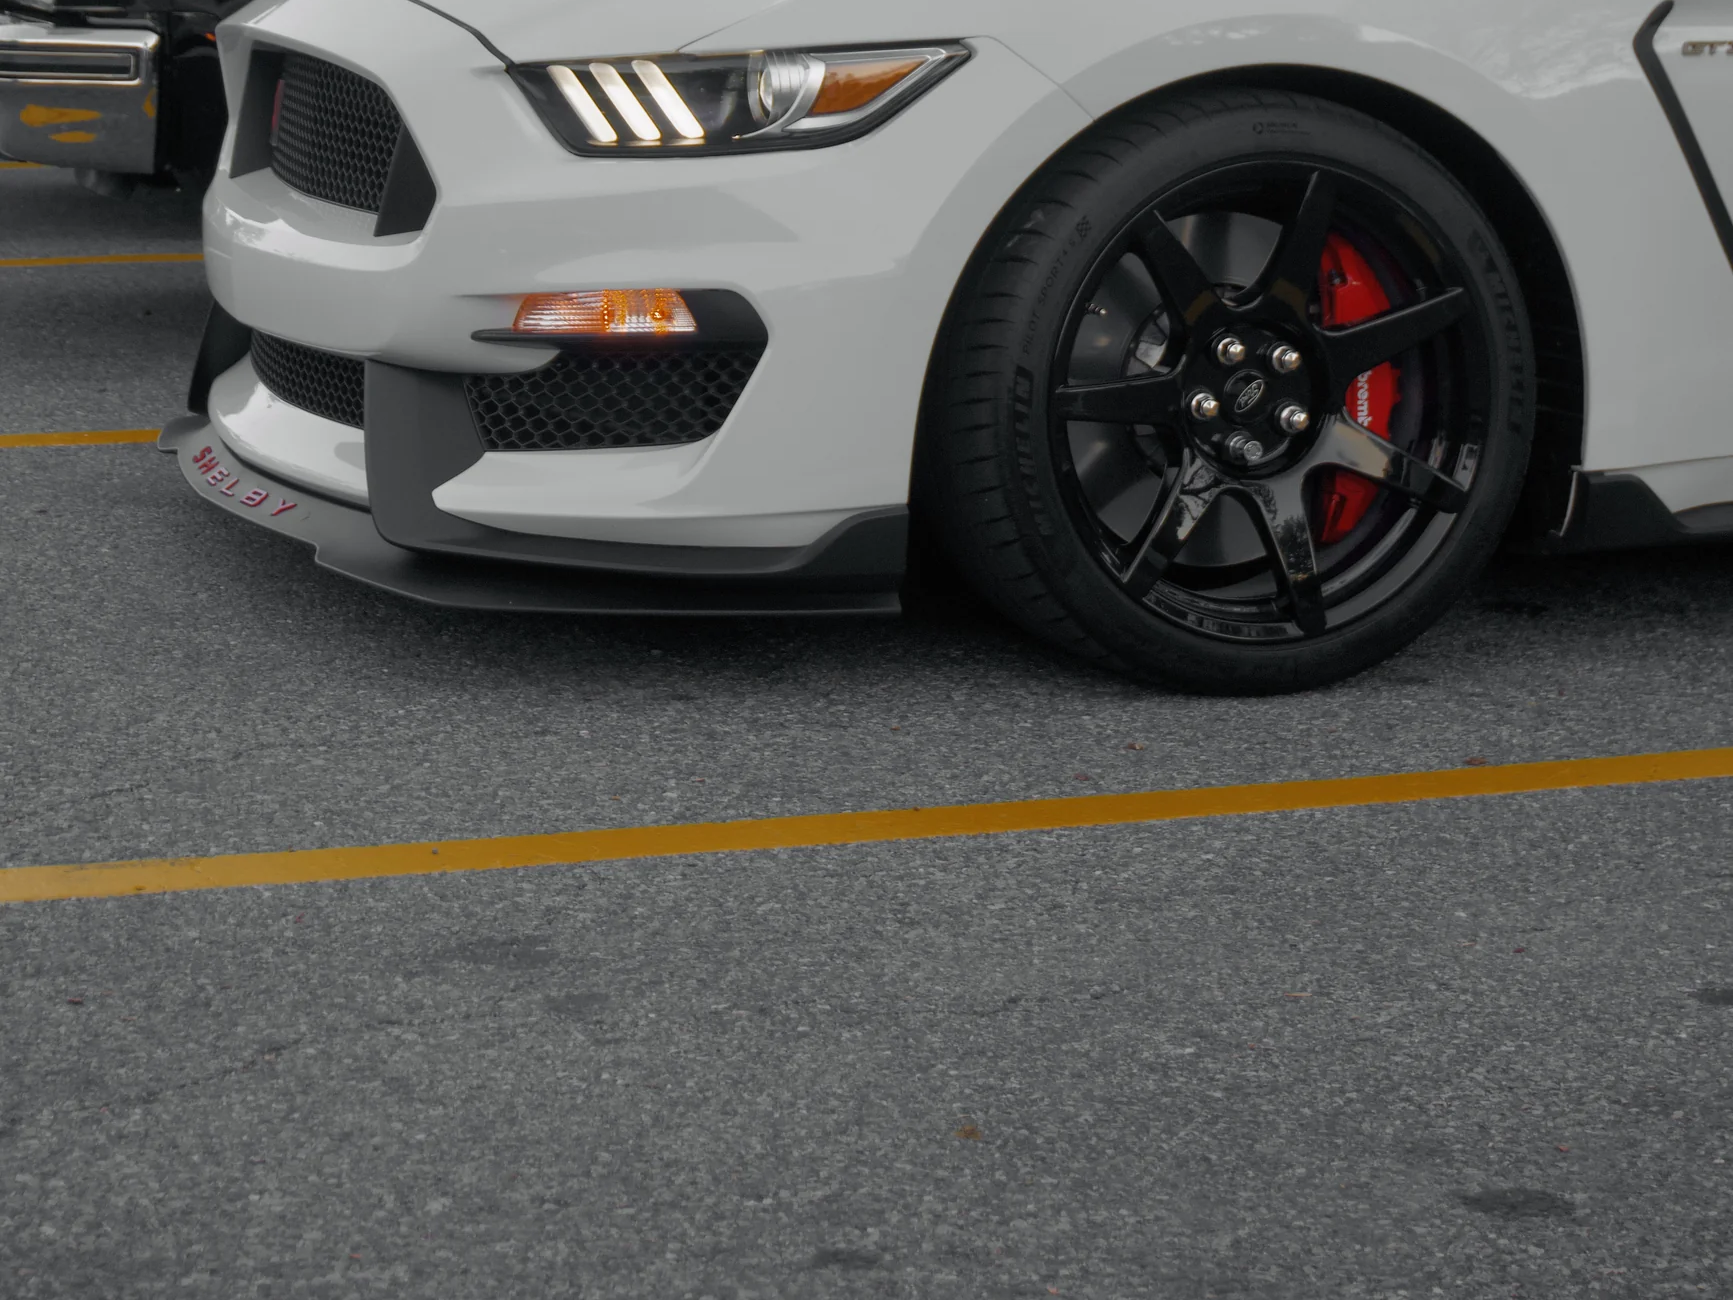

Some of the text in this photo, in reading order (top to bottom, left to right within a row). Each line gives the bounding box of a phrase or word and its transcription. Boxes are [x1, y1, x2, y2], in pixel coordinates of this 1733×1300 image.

[1023, 310, 1041, 356] PILOT
[1037, 258, 1065, 306] SPORT
[192, 446, 297, 516] SHELBY
